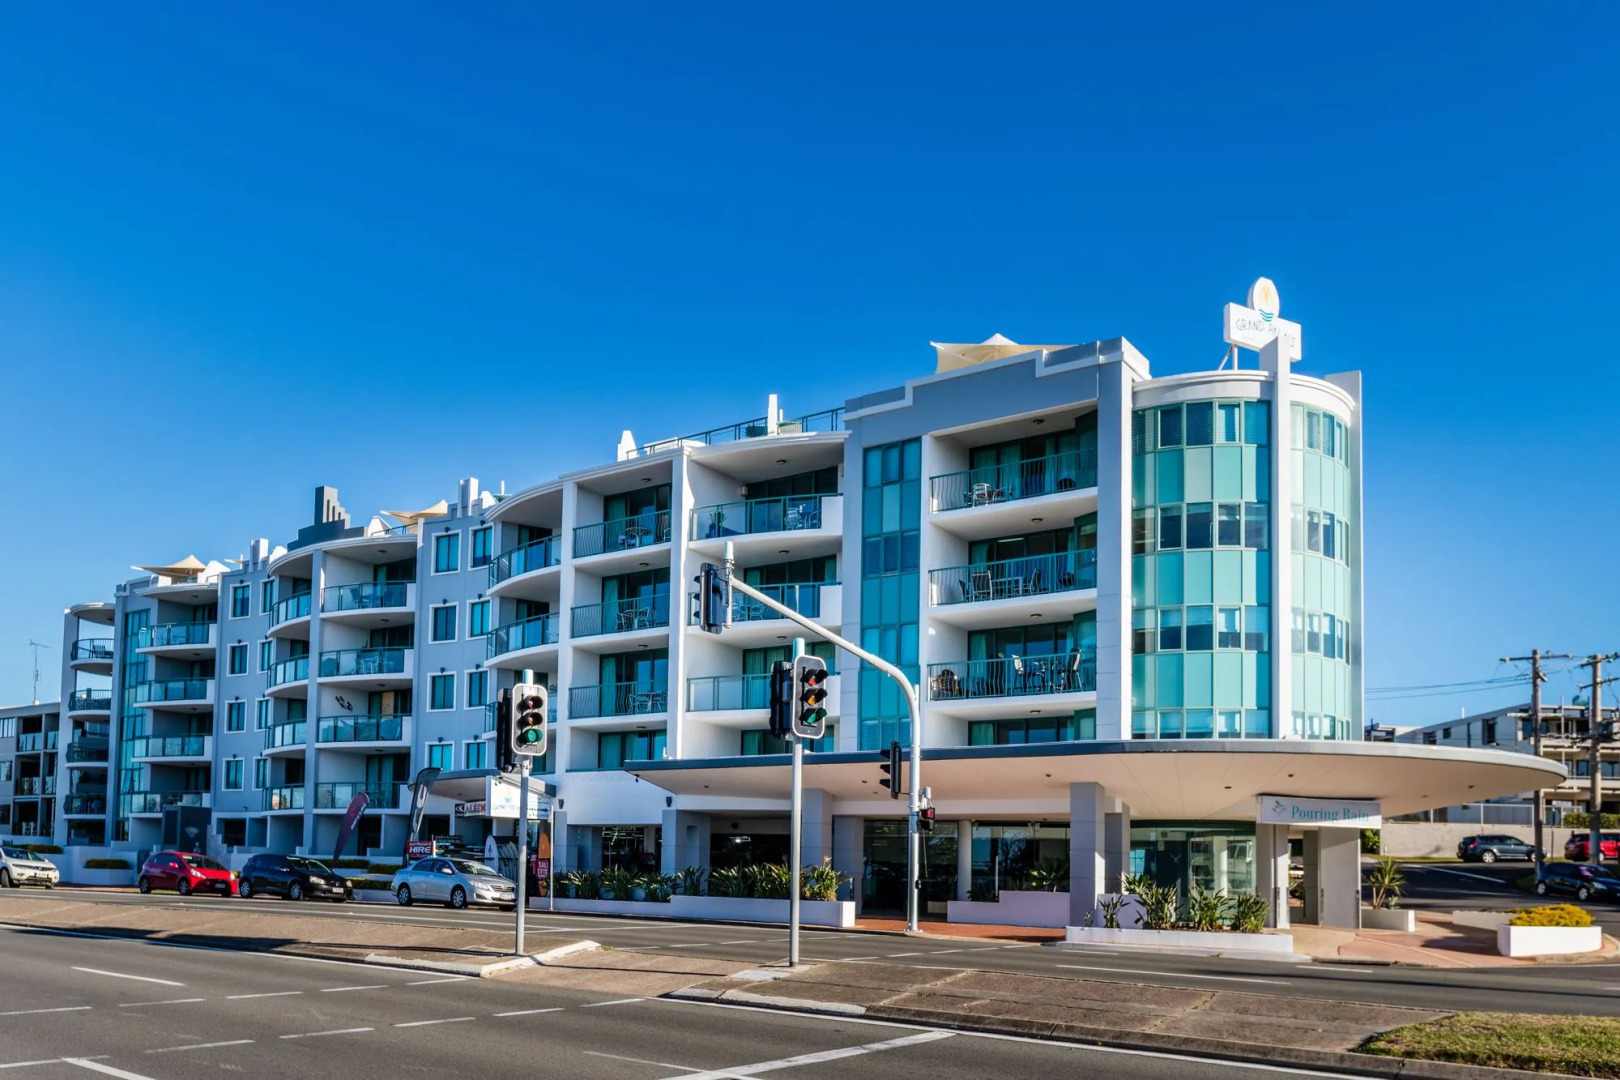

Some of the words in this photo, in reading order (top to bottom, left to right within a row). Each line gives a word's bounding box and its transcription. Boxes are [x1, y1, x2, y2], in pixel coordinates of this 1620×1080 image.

[1235, 318, 1265, 332] GRAND
[1268, 322, 1296, 348] PAS
[1291, 804, 1339, 823] Pouring
[1342, 807, 1369, 822] Rain
[409, 846, 431, 854] HIRE
